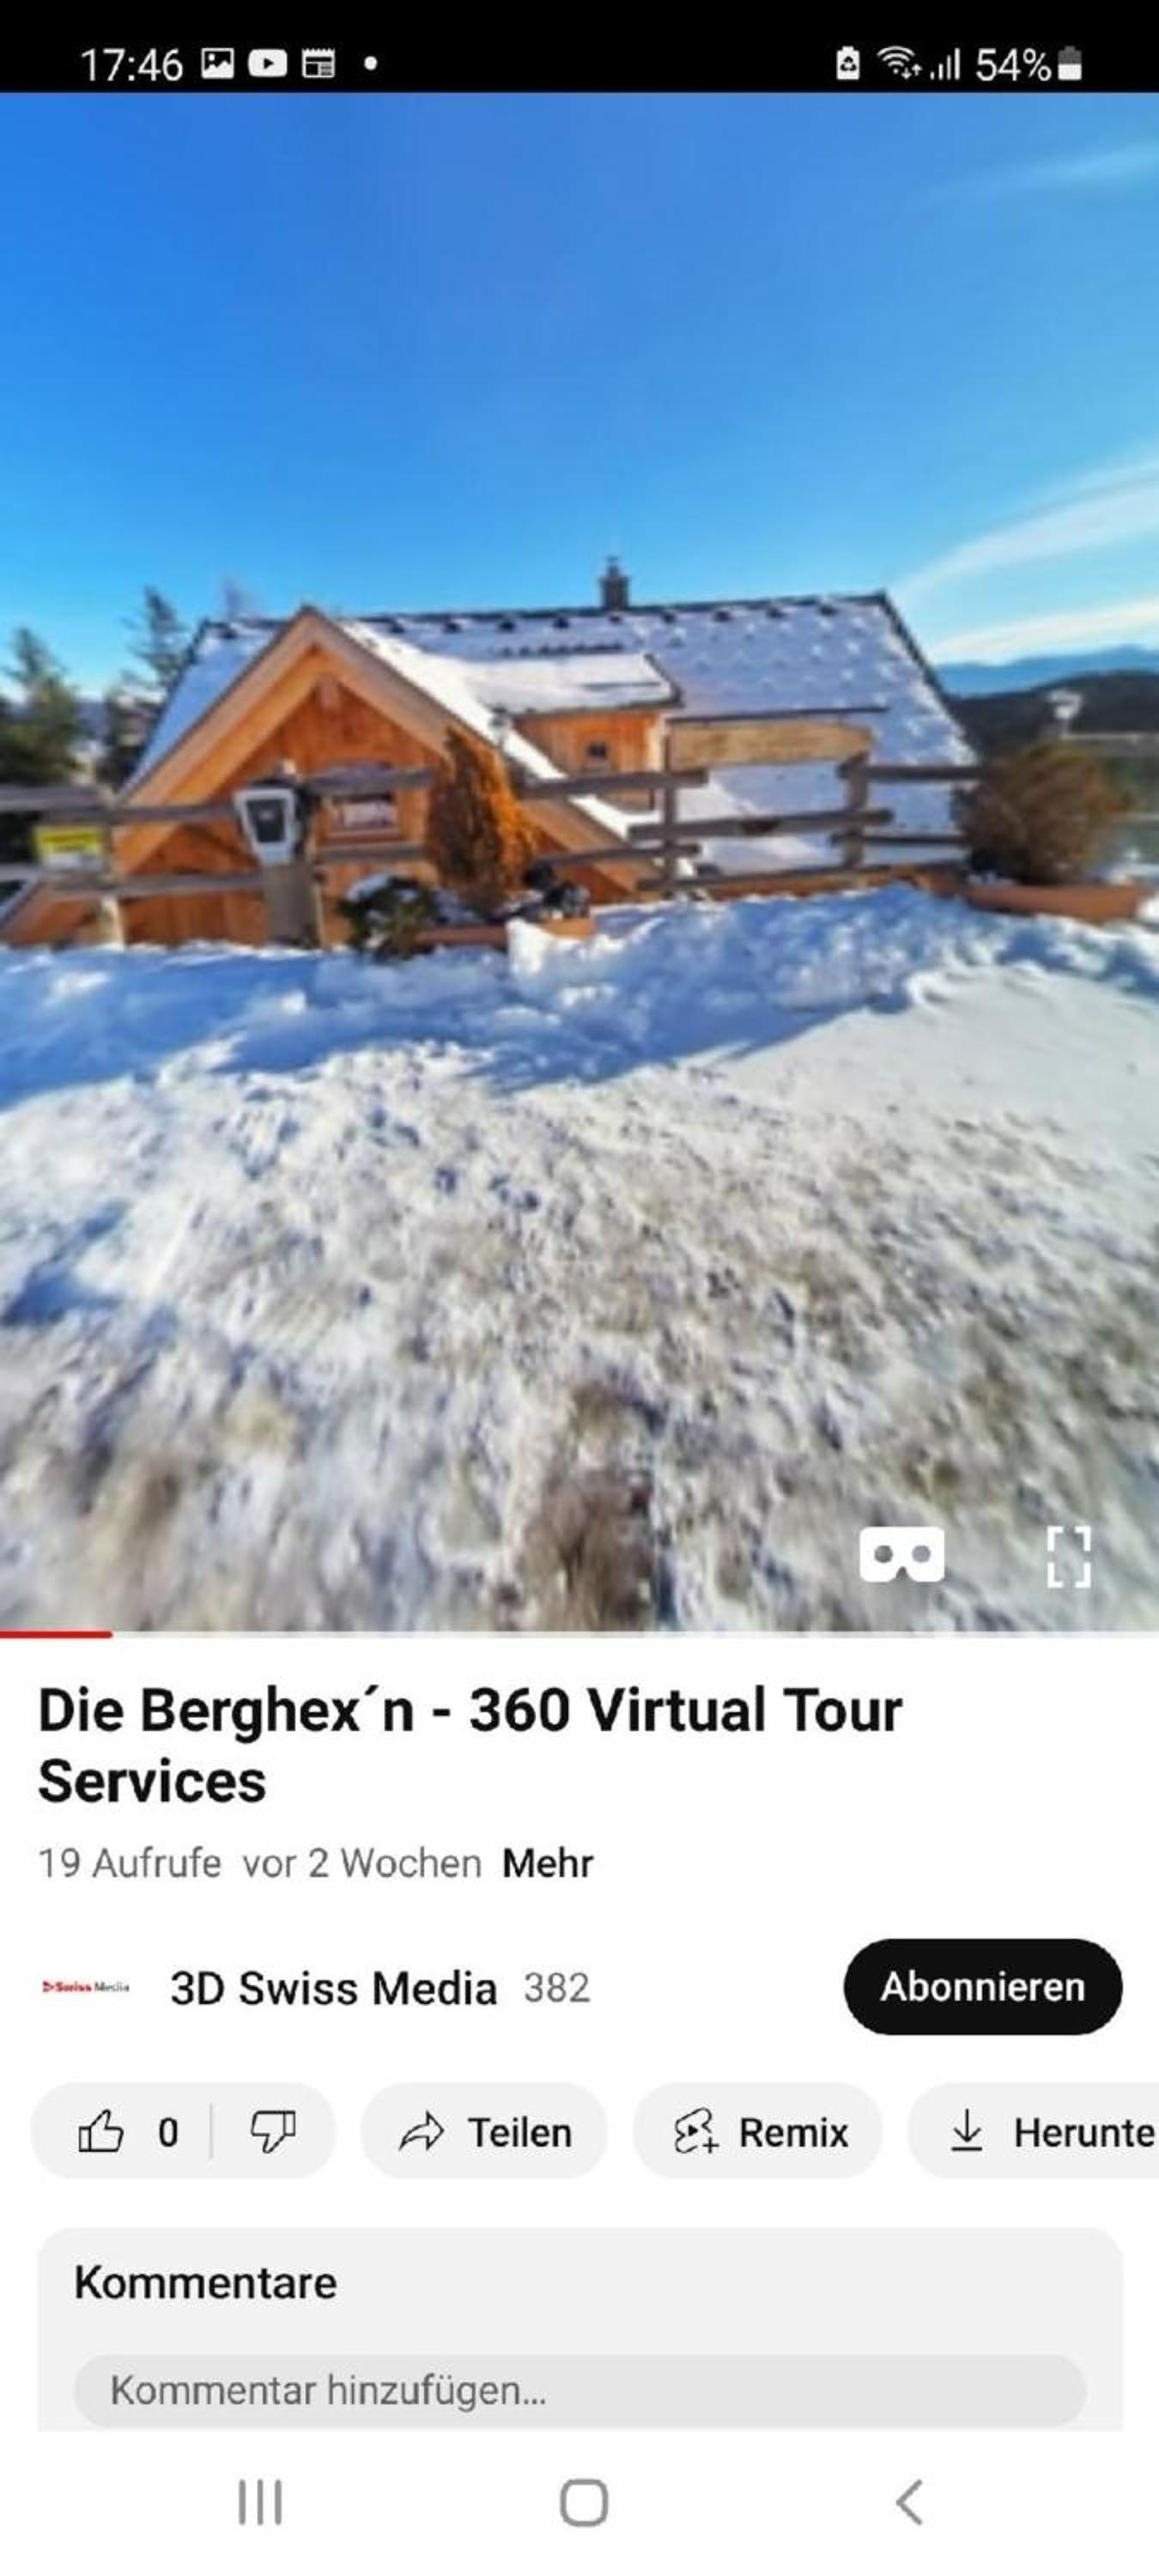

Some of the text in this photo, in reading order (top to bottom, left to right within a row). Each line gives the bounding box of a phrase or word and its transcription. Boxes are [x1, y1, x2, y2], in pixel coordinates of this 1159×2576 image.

[81, 47, 184, 82] 17:46
[975, 47, 1053, 82] 54%
[39, 1685, 124, 1733] Die
[470, 1686, 570, 1733] 360
[586, 1684, 765, 1733] Virtual
[782, 1686, 904, 1733] Tour
[38, 1756, 267, 1804] Services
[39, 1844, 596, 1879] 19 Aufrufe vor 2 Wochen Mehr
[171, 1968, 591, 2007] 3D Swiss Media 382
[879, 1968, 1085, 2002] Abonnieren
[158, 2117, 179, 2148] 0
[466, 2115, 572, 2148] Teilen
[740, 2116, 849, 2148] Remix
[1015, 2117, 1156, 2148] Herunte
[75, 2263, 337, 2300] Kommentare
[112, 2374, 318, 2405] Kommentar
